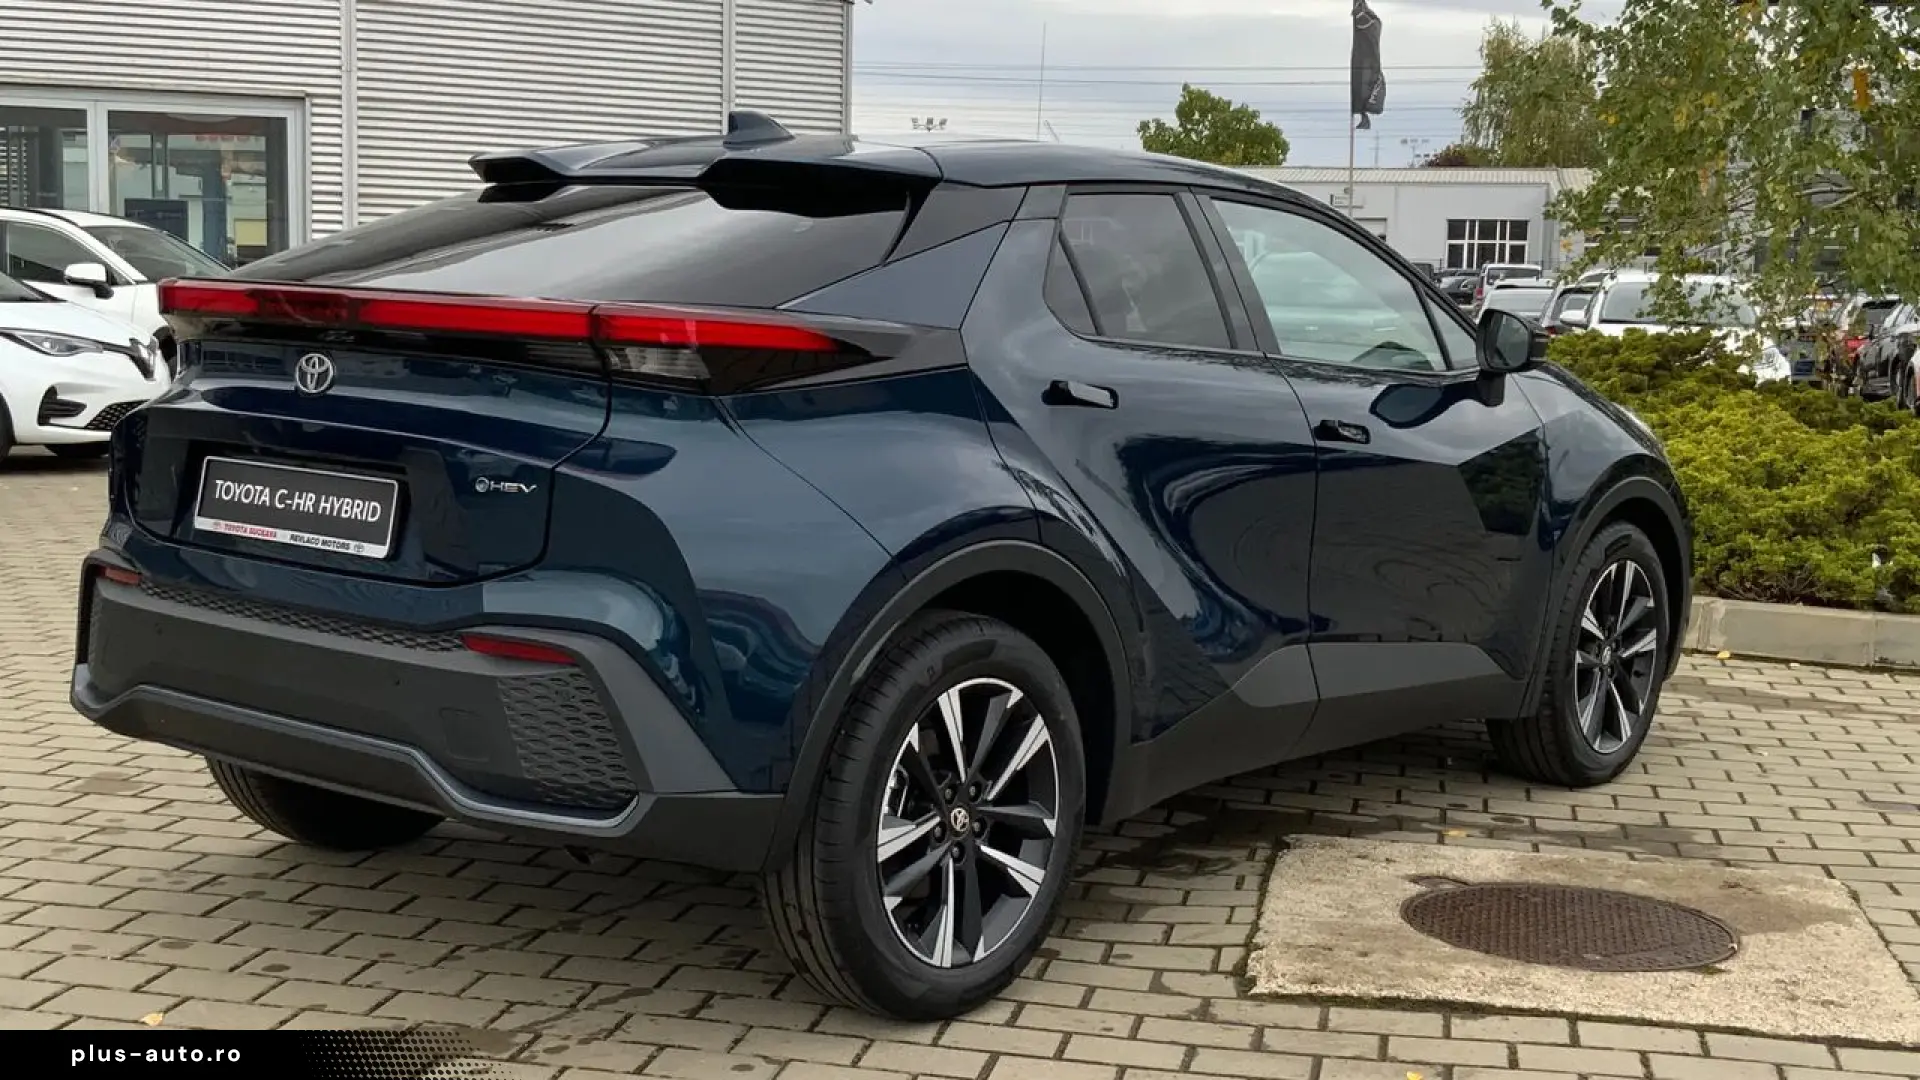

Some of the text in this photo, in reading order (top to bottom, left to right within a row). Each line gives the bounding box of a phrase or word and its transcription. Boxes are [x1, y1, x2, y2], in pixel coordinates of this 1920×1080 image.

[215, 479, 382, 523] TOYOTA C-HR HYBRID
[224, 522, 247, 534] TOYOTA
[321, 538, 350, 551] MOTORS
